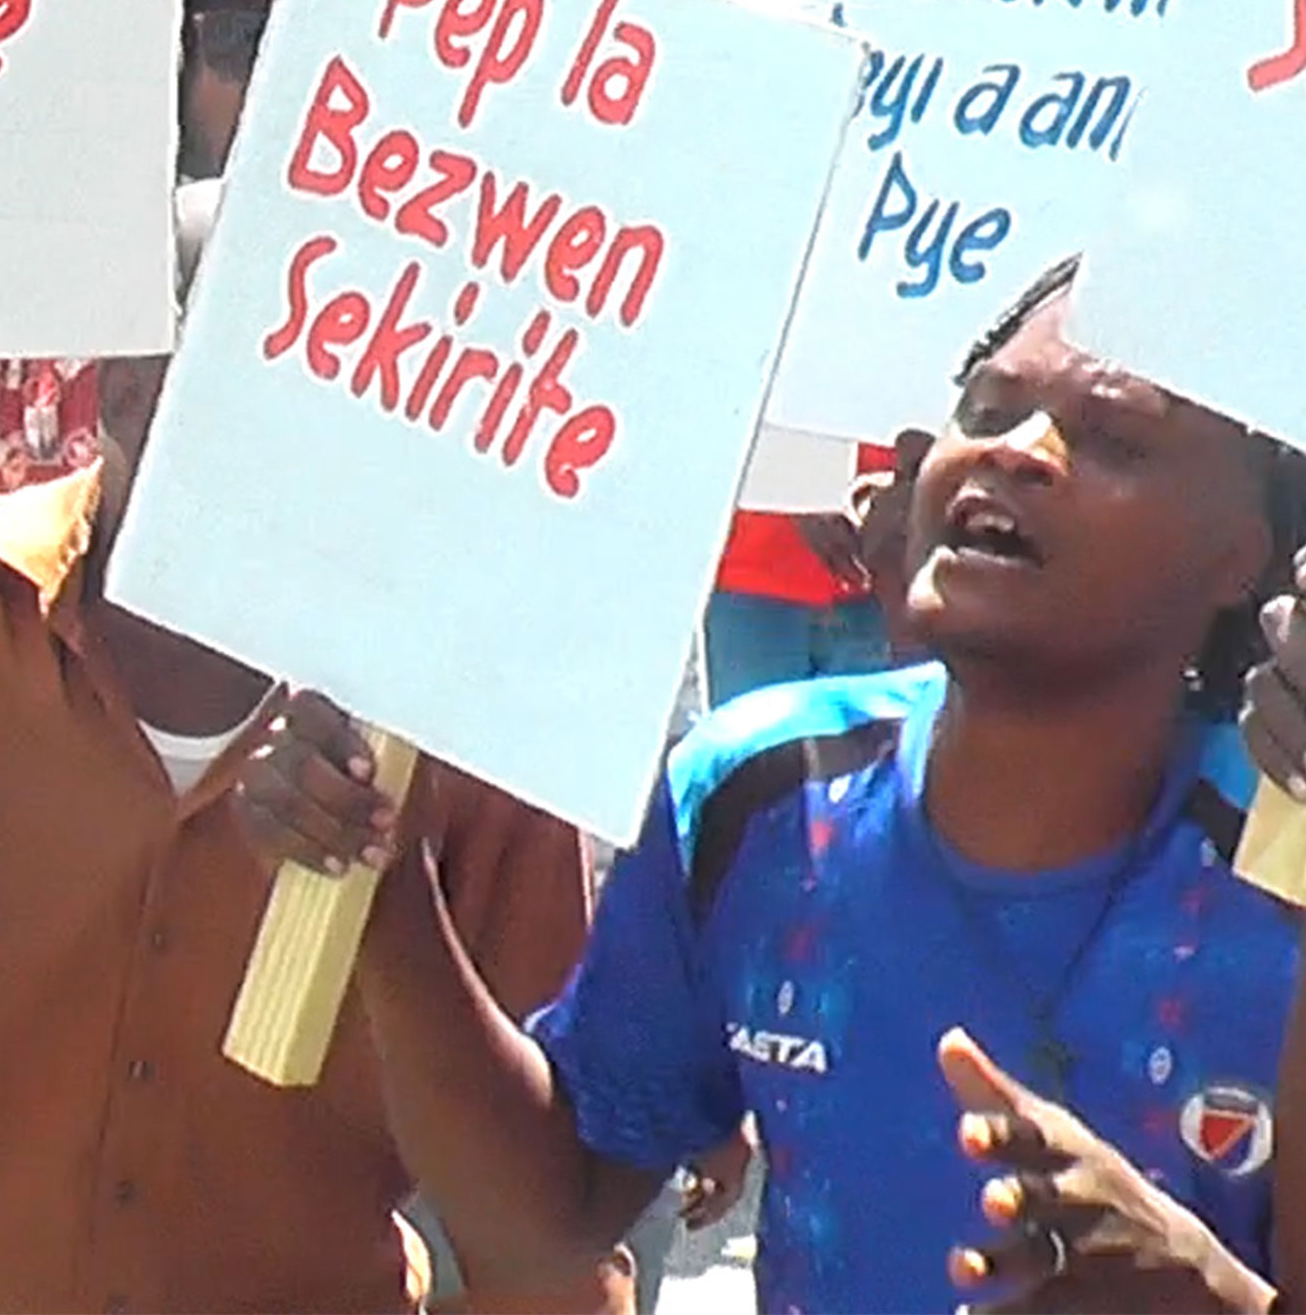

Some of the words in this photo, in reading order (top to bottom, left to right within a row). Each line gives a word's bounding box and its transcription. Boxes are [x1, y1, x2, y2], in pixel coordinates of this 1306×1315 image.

[286, 53, 666, 327] Bezwen
[858, 150, 1012, 299] Pye
[260, 233, 618, 499] Sekirite
